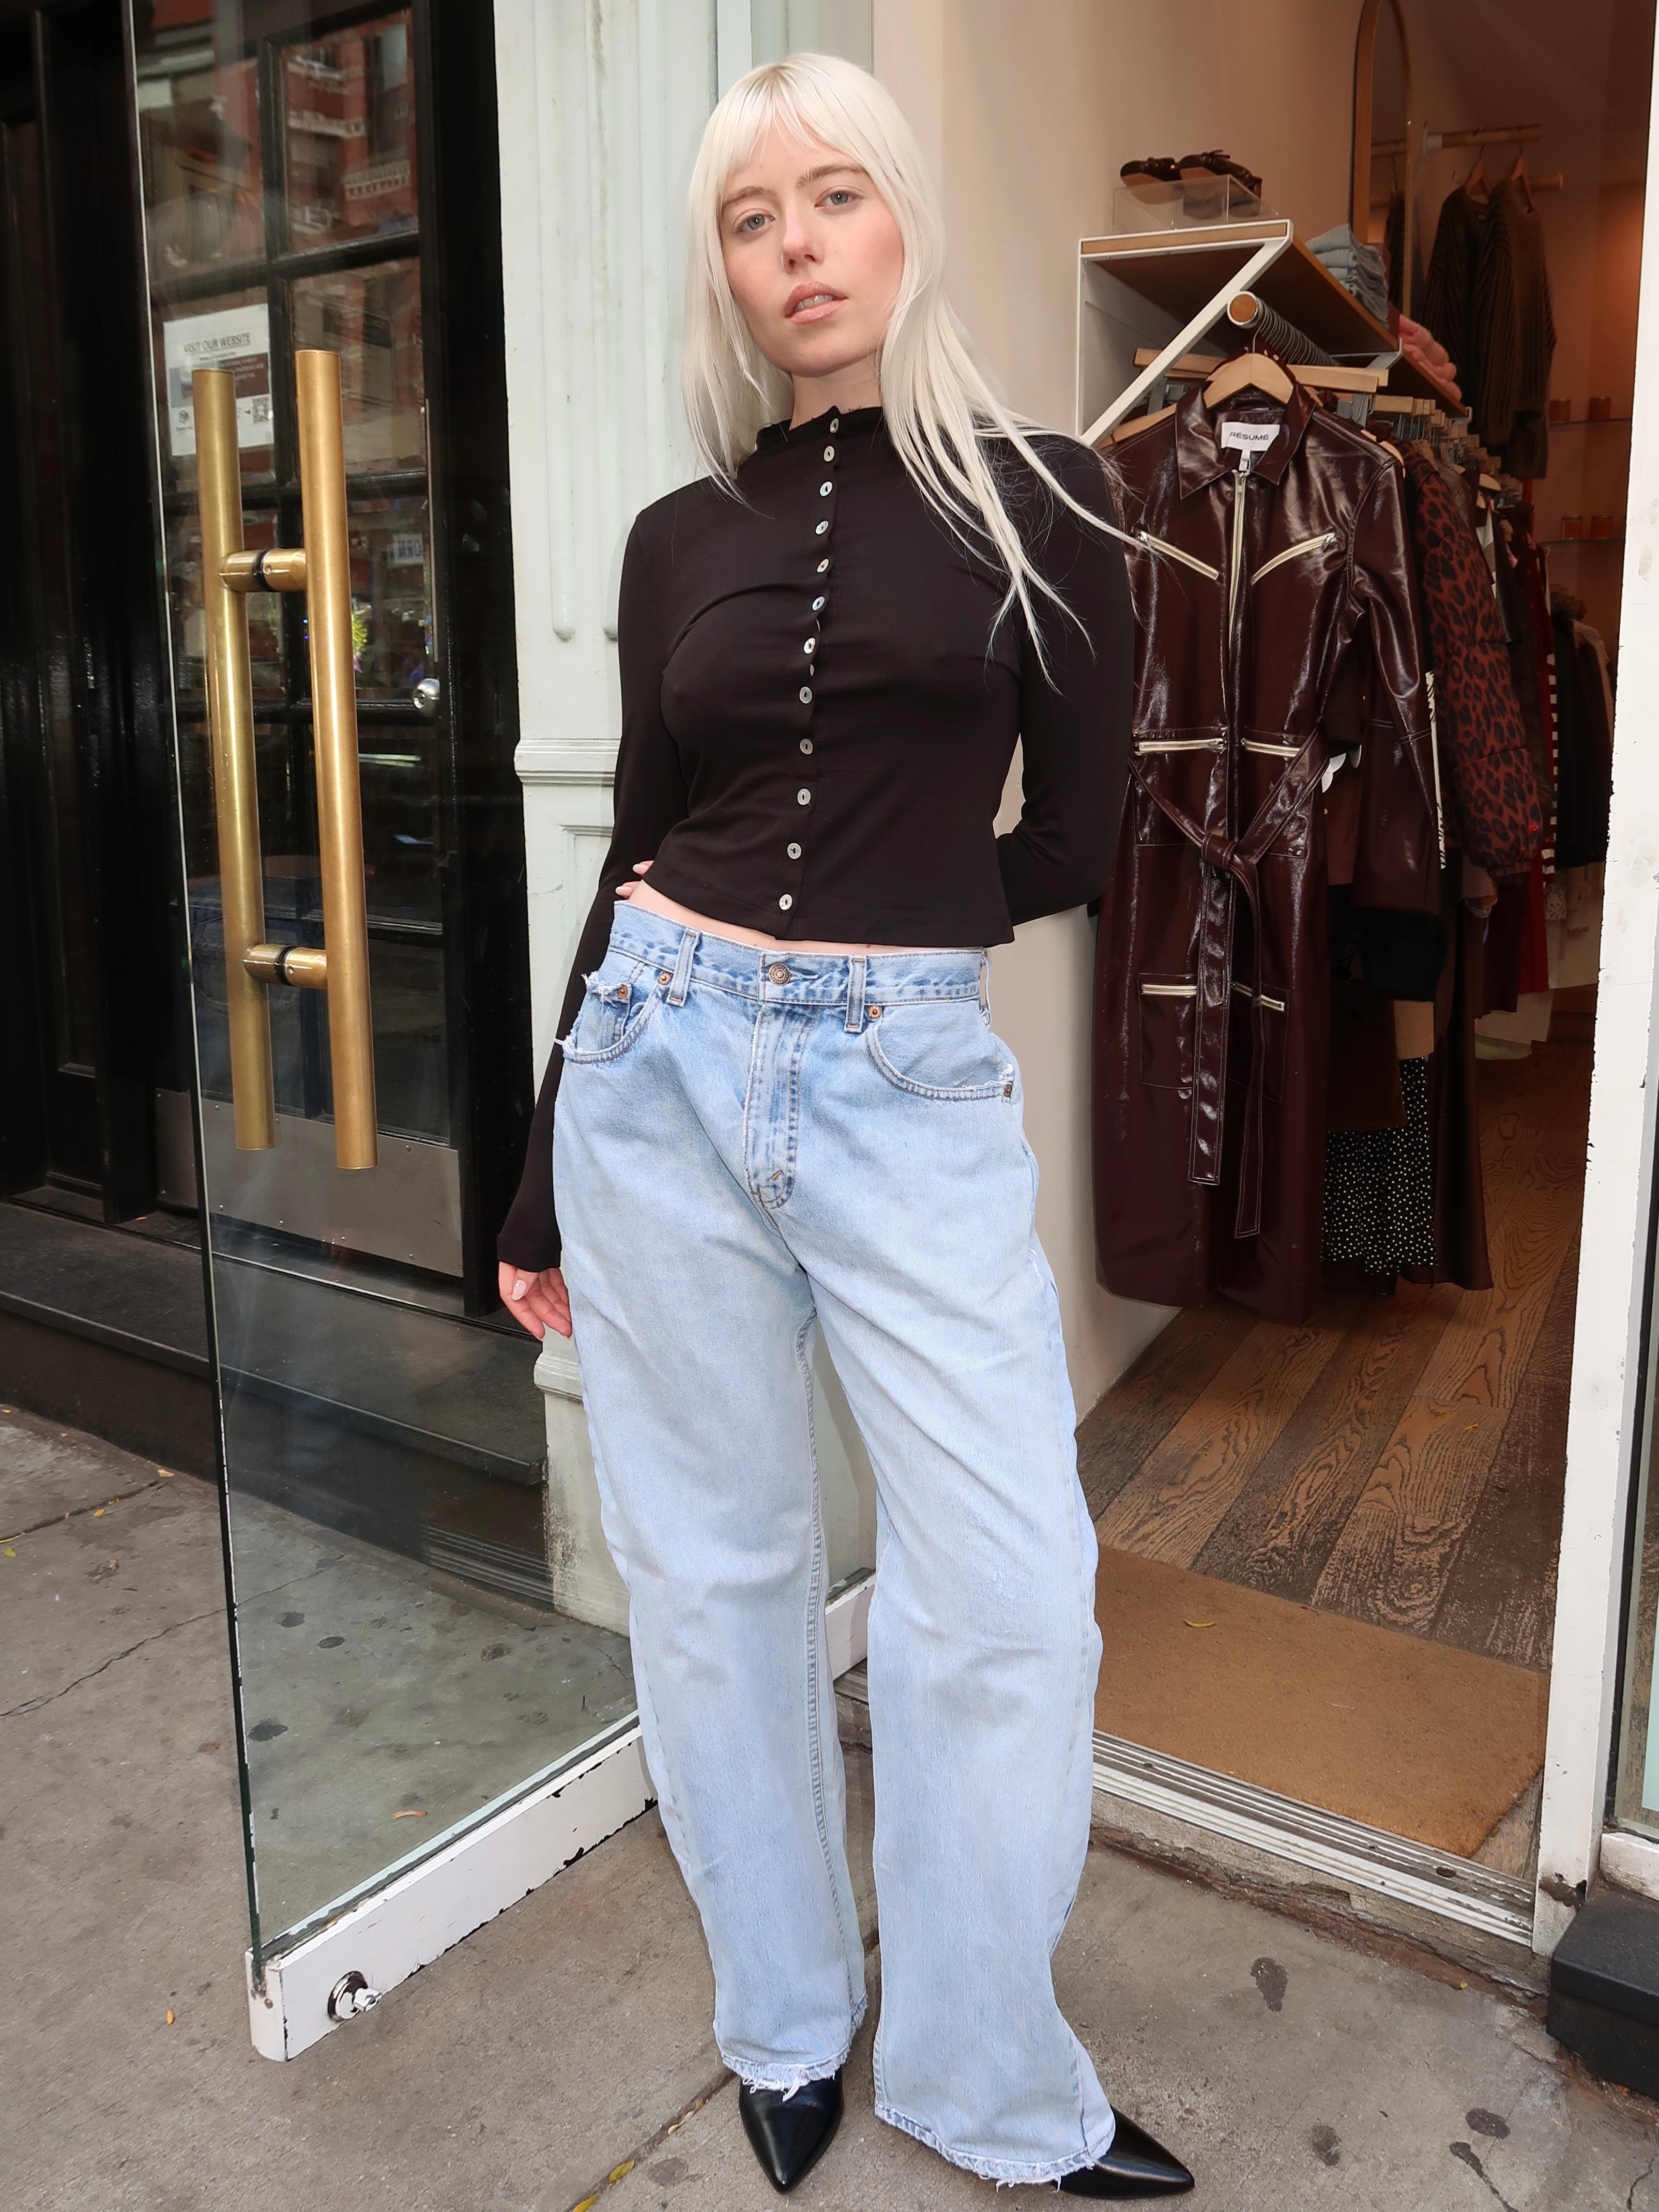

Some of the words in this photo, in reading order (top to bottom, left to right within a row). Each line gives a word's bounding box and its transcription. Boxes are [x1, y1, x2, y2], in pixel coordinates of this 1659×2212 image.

[182, 341, 200, 352] VISIT
[202, 338, 218, 350] OUR
[219, 332, 250, 347] WEBSITE
[1229, 431, 1269, 440] RÉSUMÉ
